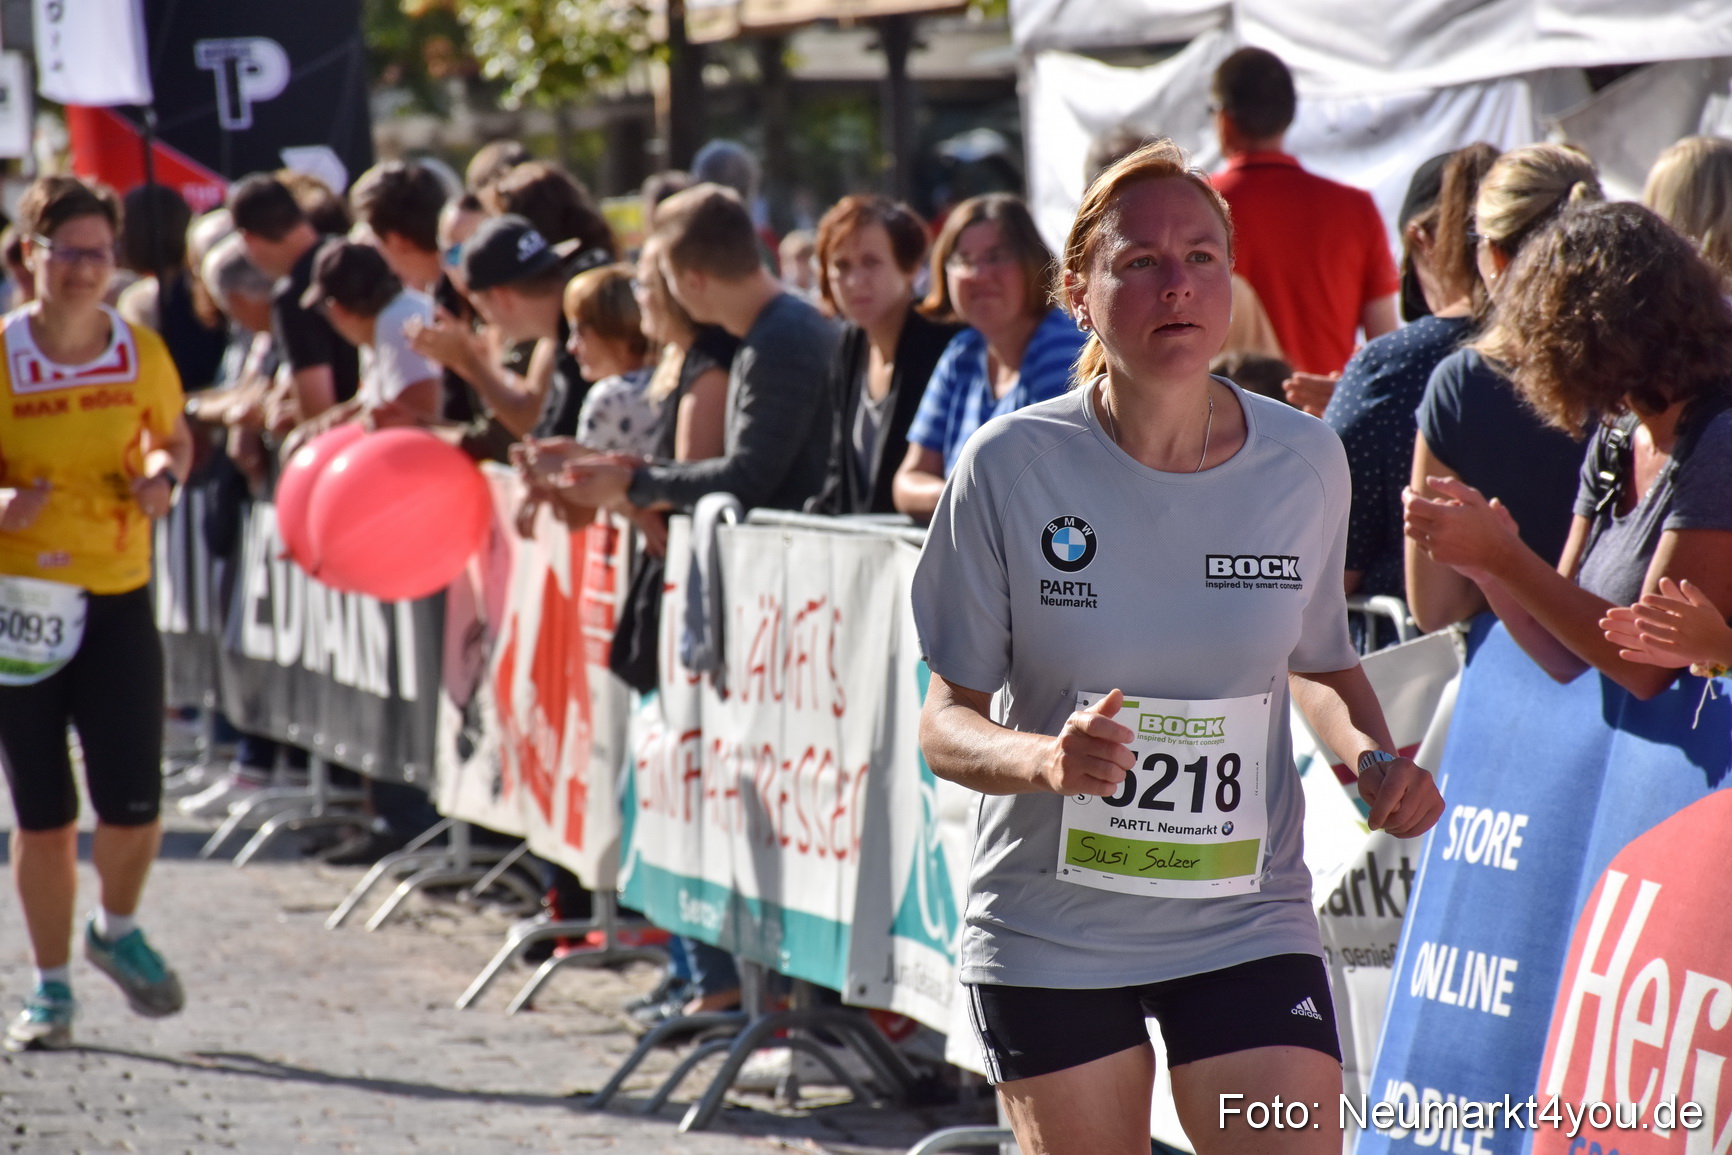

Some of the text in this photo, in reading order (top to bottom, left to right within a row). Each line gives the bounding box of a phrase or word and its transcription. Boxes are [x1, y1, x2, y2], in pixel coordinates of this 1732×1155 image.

[1047, 517, 1093, 537] BMW
[1206, 555, 1302, 581] BOCK
[1040, 579, 1098, 597] PARTL
[1206, 580, 1303, 591] inspired by smart concepts
[1040, 595, 1098, 609] Neumarkt
[1138, 713, 1226, 738] BOCK
[1137, 733, 1166, 743] inspired
[1200, 738, 1225, 746] concepts
[1109, 817, 1218, 836] PARTL Neumarkt
[1442, 805, 1529, 871] STORE
[1072, 836, 1201, 872] Susi Salzer
[1319, 851, 1417, 918] arkt
[1410, 941, 1518, 1017] ONLINE
[1291, 1008, 1322, 1020] adidas
